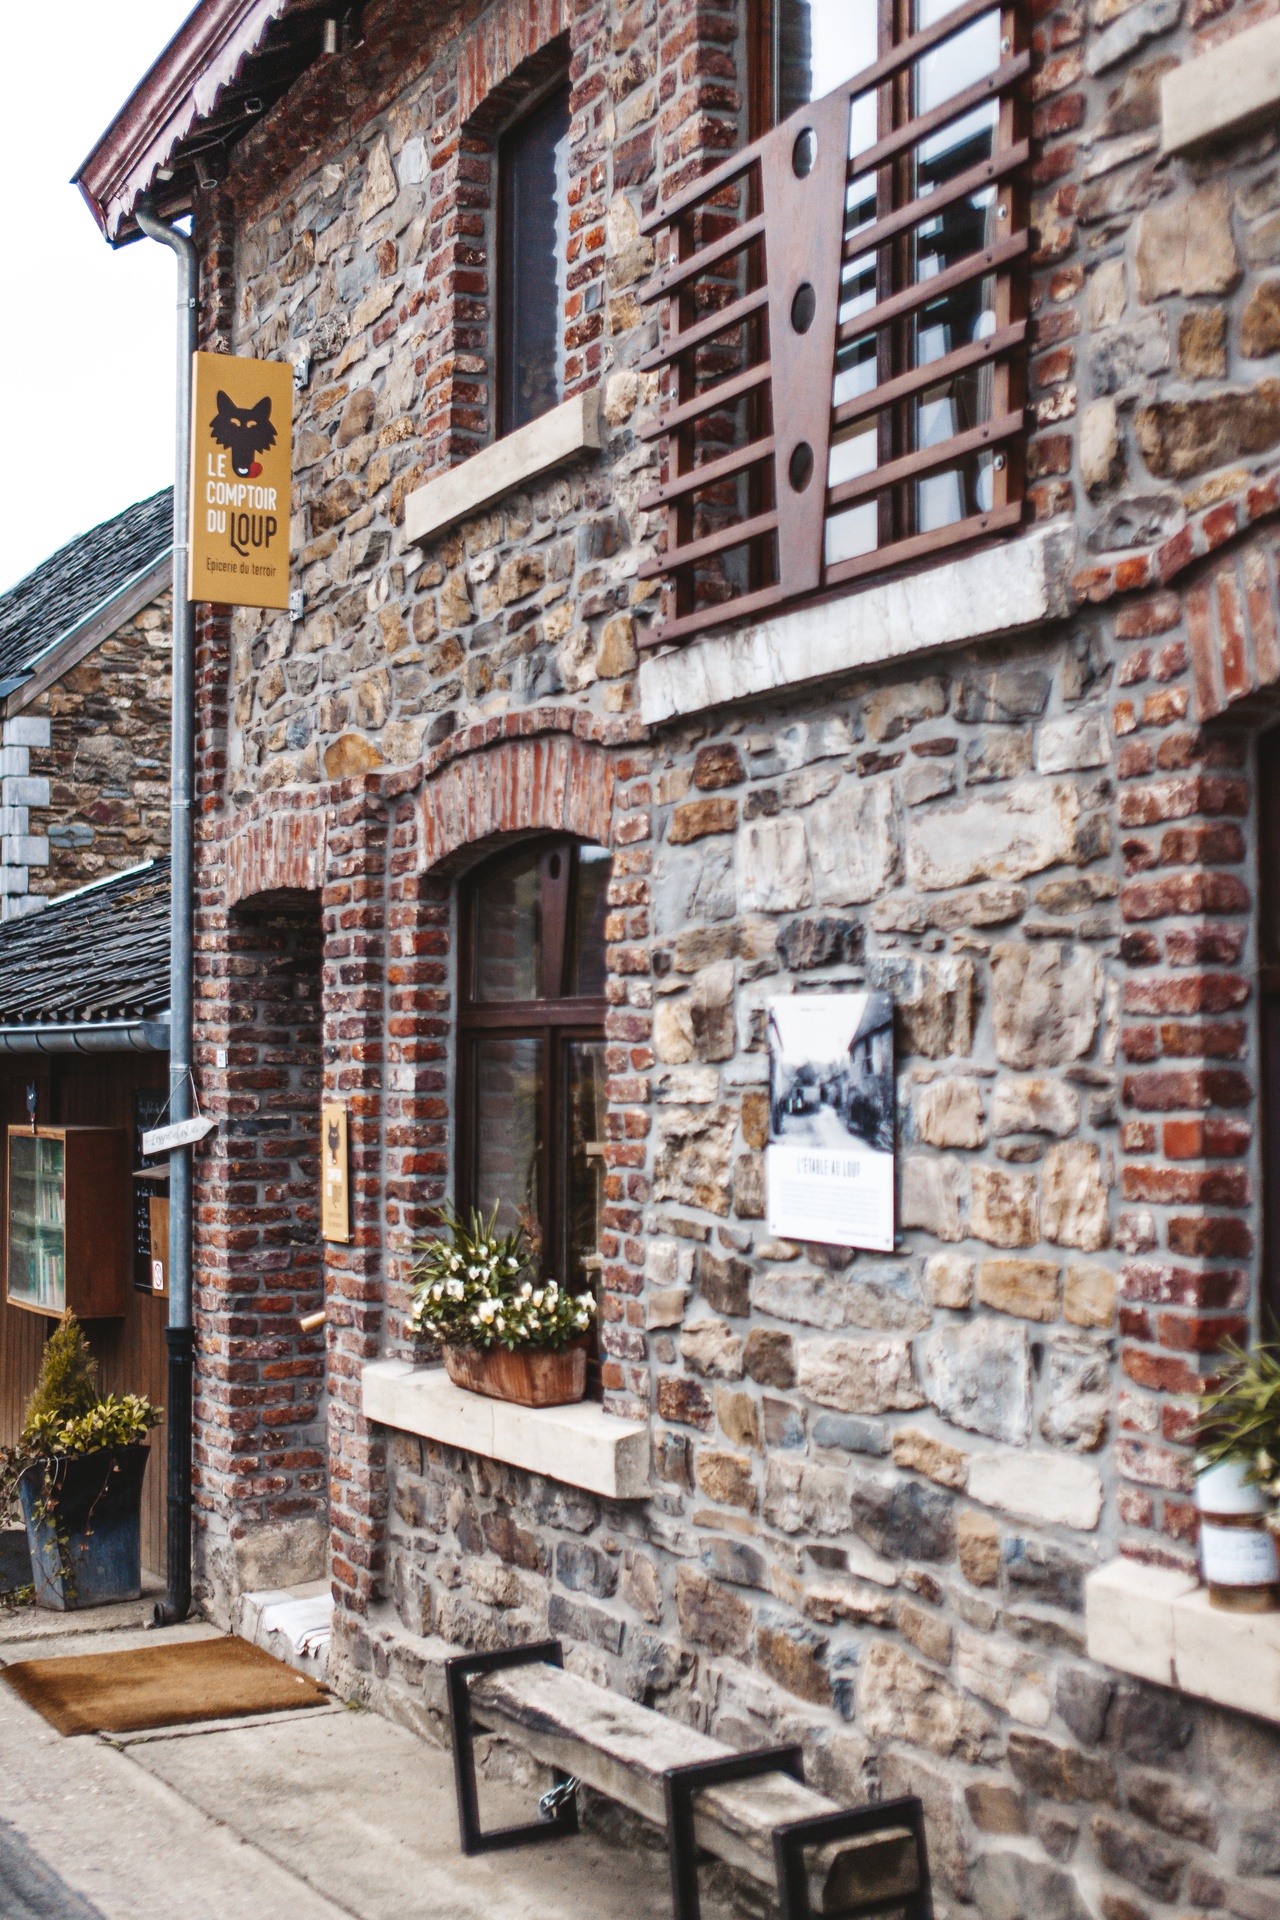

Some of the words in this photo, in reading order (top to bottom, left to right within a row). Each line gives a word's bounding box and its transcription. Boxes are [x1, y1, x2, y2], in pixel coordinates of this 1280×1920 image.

[207, 453, 227, 478] LE
[206, 480, 278, 512] COMPTOIR
[206, 508, 227, 534] DU
[230, 511, 278, 557] LOUP
[206, 557, 238, 575] Epicerie
[240, 561, 250, 575] du
[252, 563, 277, 577] terroir
[796, 1153, 828, 1176] L'ÉTABLE
[831, 1159, 841, 1177] AU
[843, 1160, 861, 1178] LOUP
